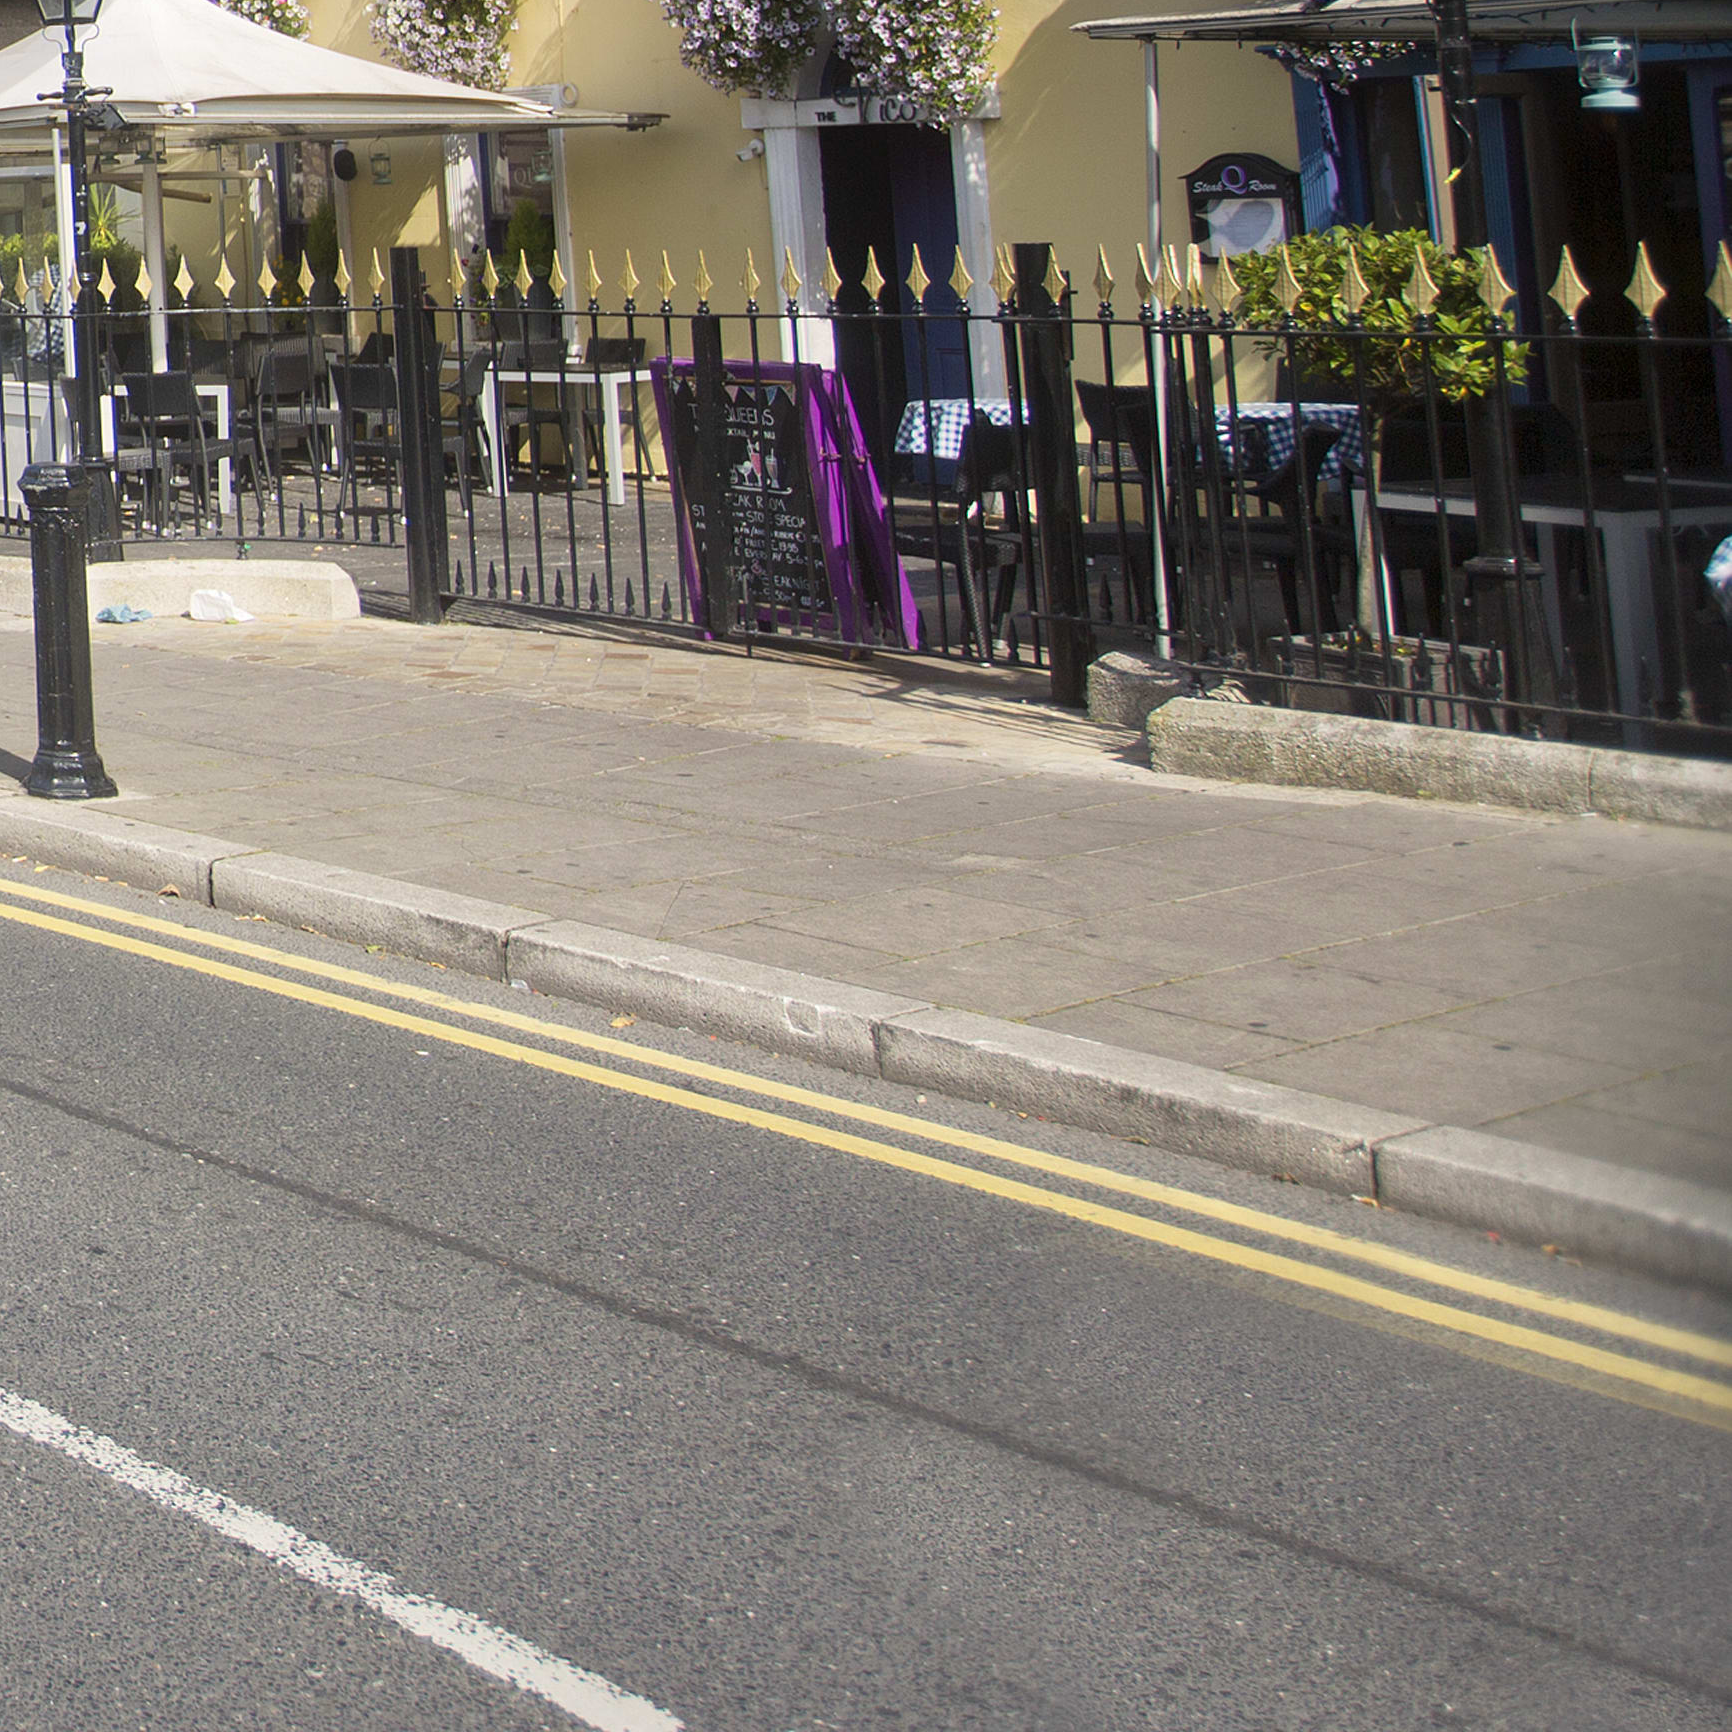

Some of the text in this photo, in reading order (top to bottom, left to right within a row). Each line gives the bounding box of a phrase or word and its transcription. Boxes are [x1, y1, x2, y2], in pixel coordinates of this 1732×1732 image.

[1192, 165, 1277, 195] Steak Q Room
